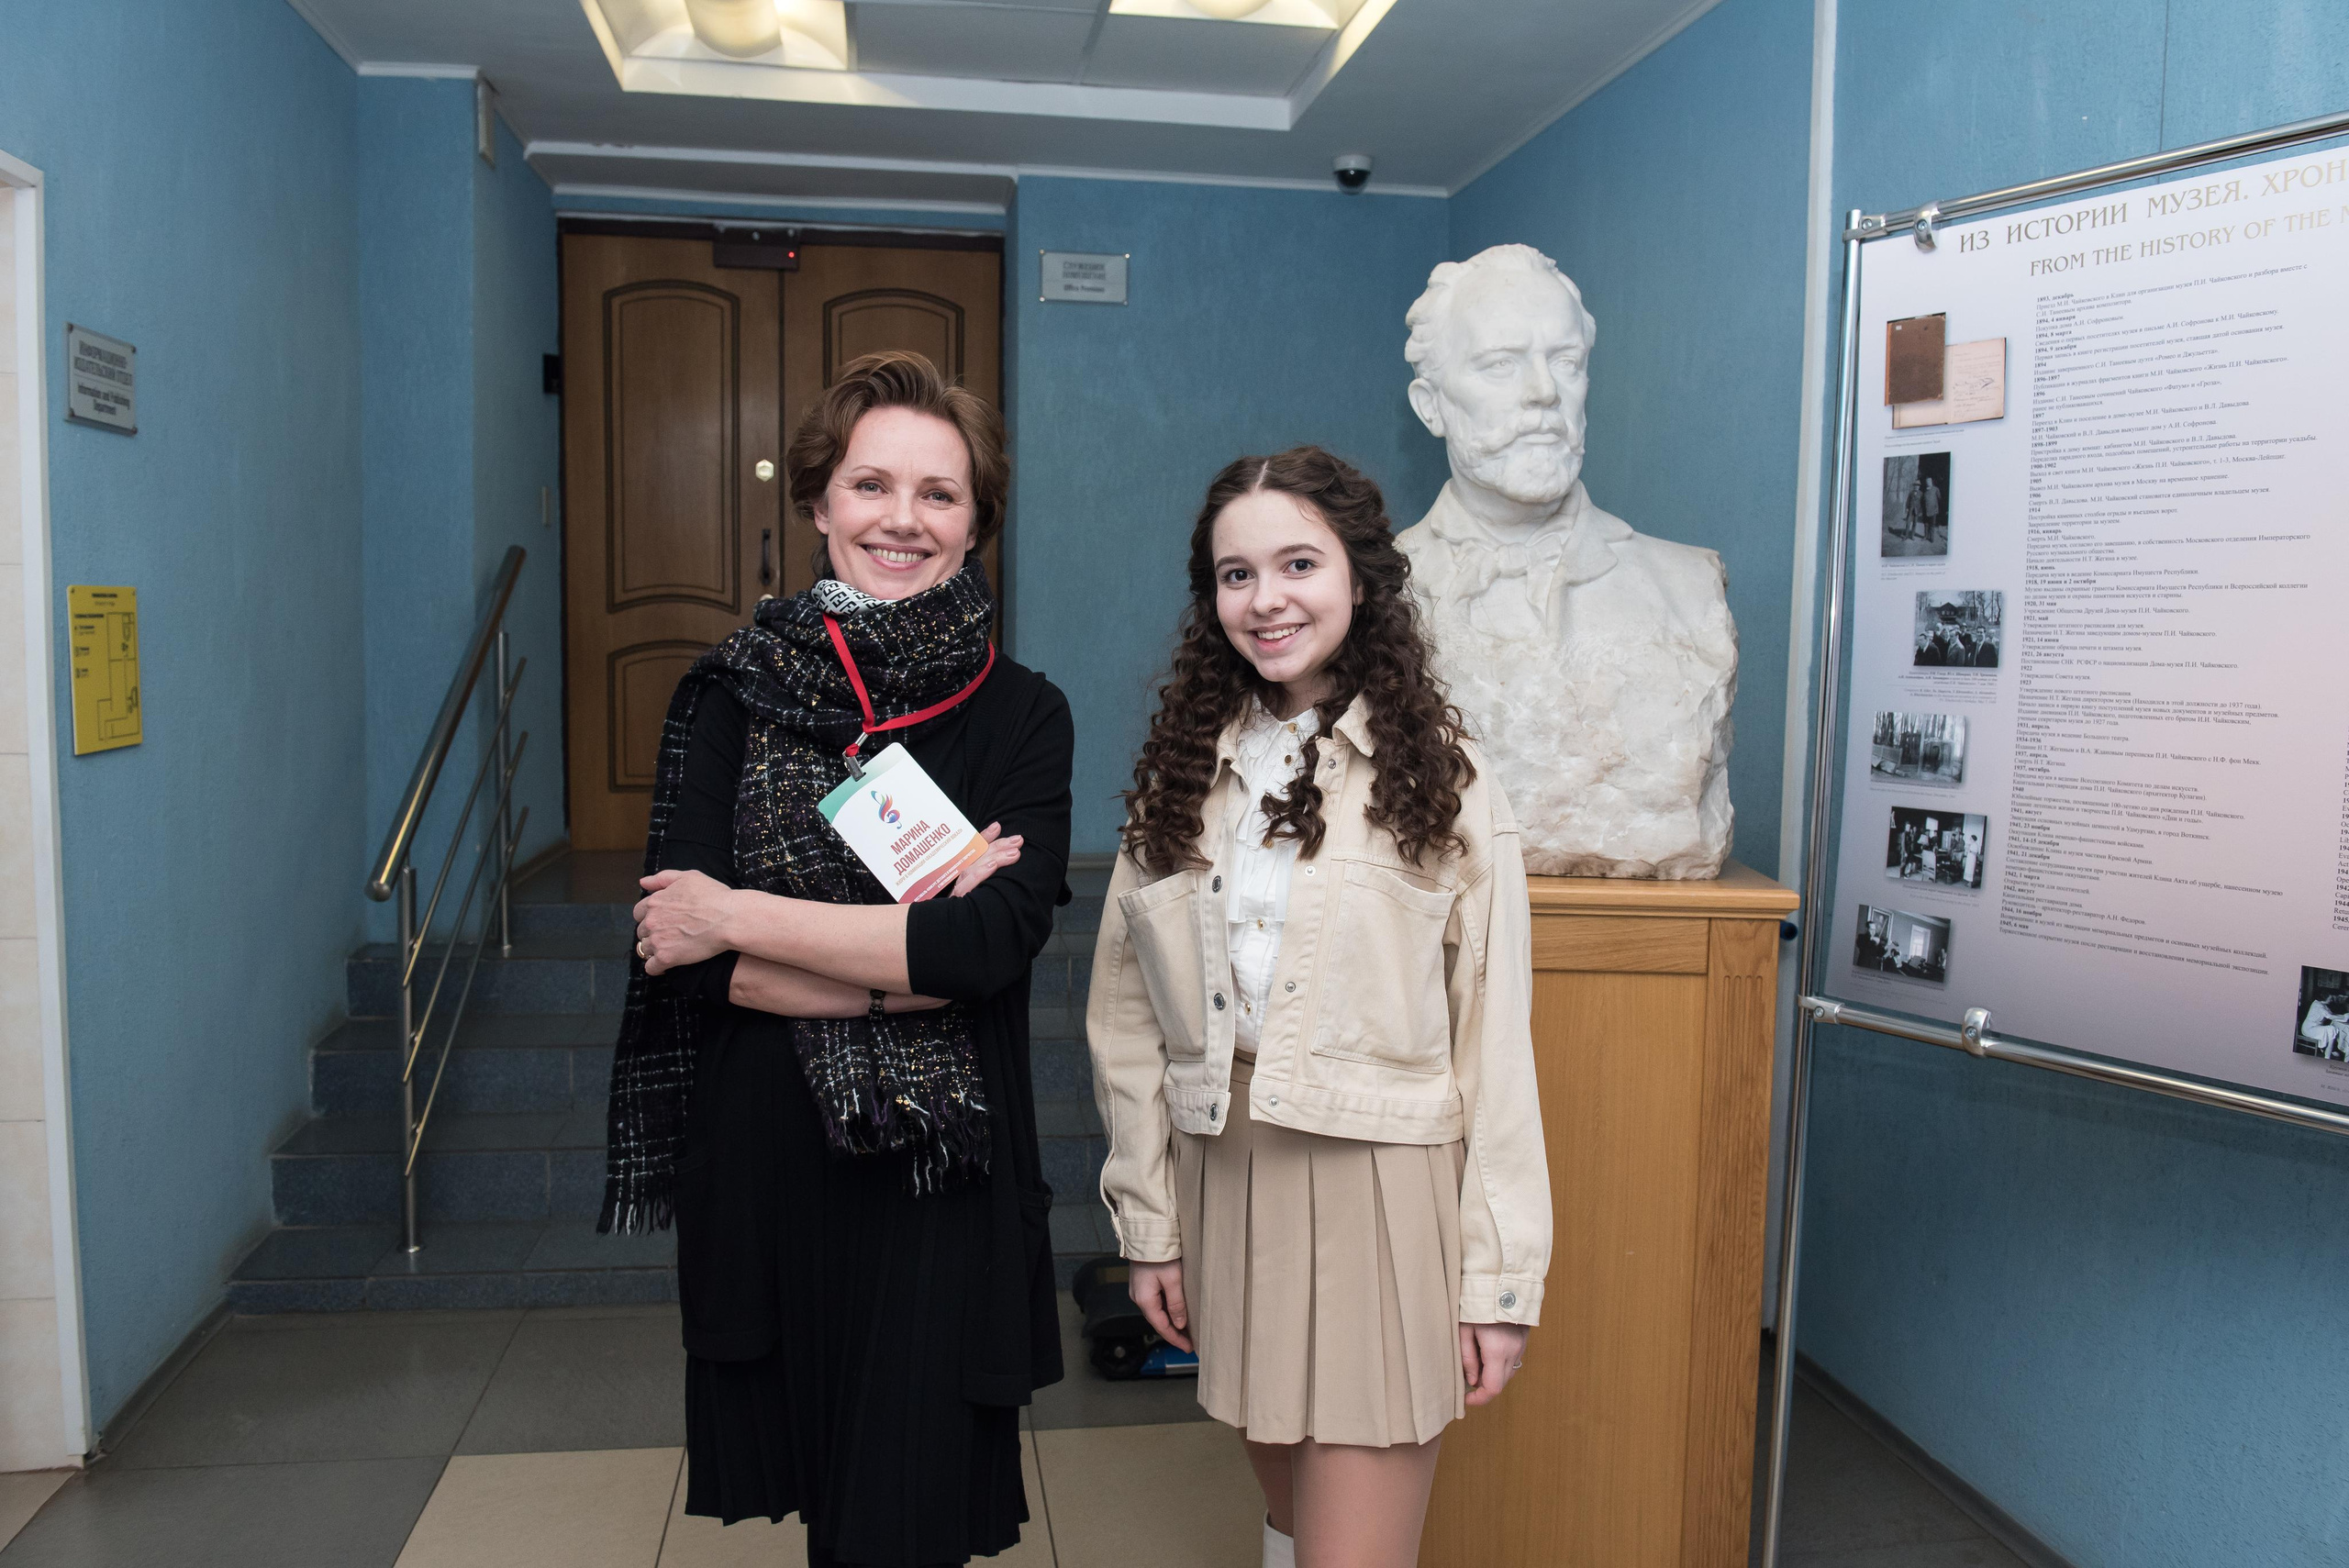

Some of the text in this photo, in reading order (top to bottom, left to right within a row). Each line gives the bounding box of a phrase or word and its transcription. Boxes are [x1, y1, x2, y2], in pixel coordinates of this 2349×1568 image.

[1960, 159, 2349, 253] ИЗ ИСТОРИИ МУЗЕЯ. ХРОН
[2030, 252, 2086, 277] FROM
[2092, 244, 2133, 265] THE
[2140, 226, 2235, 259] HISTORY
[2243, 218, 2277, 239] OF
[2284, 208, 2332, 232] THE
[2209, 273, 2247, 284] Чайковского
[2254, 269, 2278, 278] разбора
[2279, 264, 2302, 272] вместе
[2180, 317, 2214, 327] Софронова
[2237, 309, 2279, 318] Чайковскому.
[2211, 330, 2229, 339] датой
[2230, 328, 2263, 336] основания
[2182, 349, 2221, 358] Джульетта».
[2244, 357, 2289, 365] Чайковского».
[2250, 438, 2288, 446] территории
[2288, 435, 2318, 443] усадьбы.
[2232, 454, 2287, 462] Москва-Лейпциг.
[2212, 717, 2251, 725] Чайковским,
[2178, 793, 2207, 801] Кулагин).
[2205, 810, 2246, 819] Чайковского.
[890, 819, 930, 855] МАРИНА
[2180, 831, 2211, 840] Воткинск.
[893, 822, 952, 876] ДОМАШЕНКО
[2198, 881, 2222, 889] ущербе,
[2223, 884, 2261, 893] нанесенном
[2170, 940, 2199, 948] основных
[2201, 944, 2232, 953] музейных
[2232, 949, 2268, 959] коллекций.
[2186, 958, 2230, 969] мемориальной
[2231, 964, 2270, 975] экспозиции.
